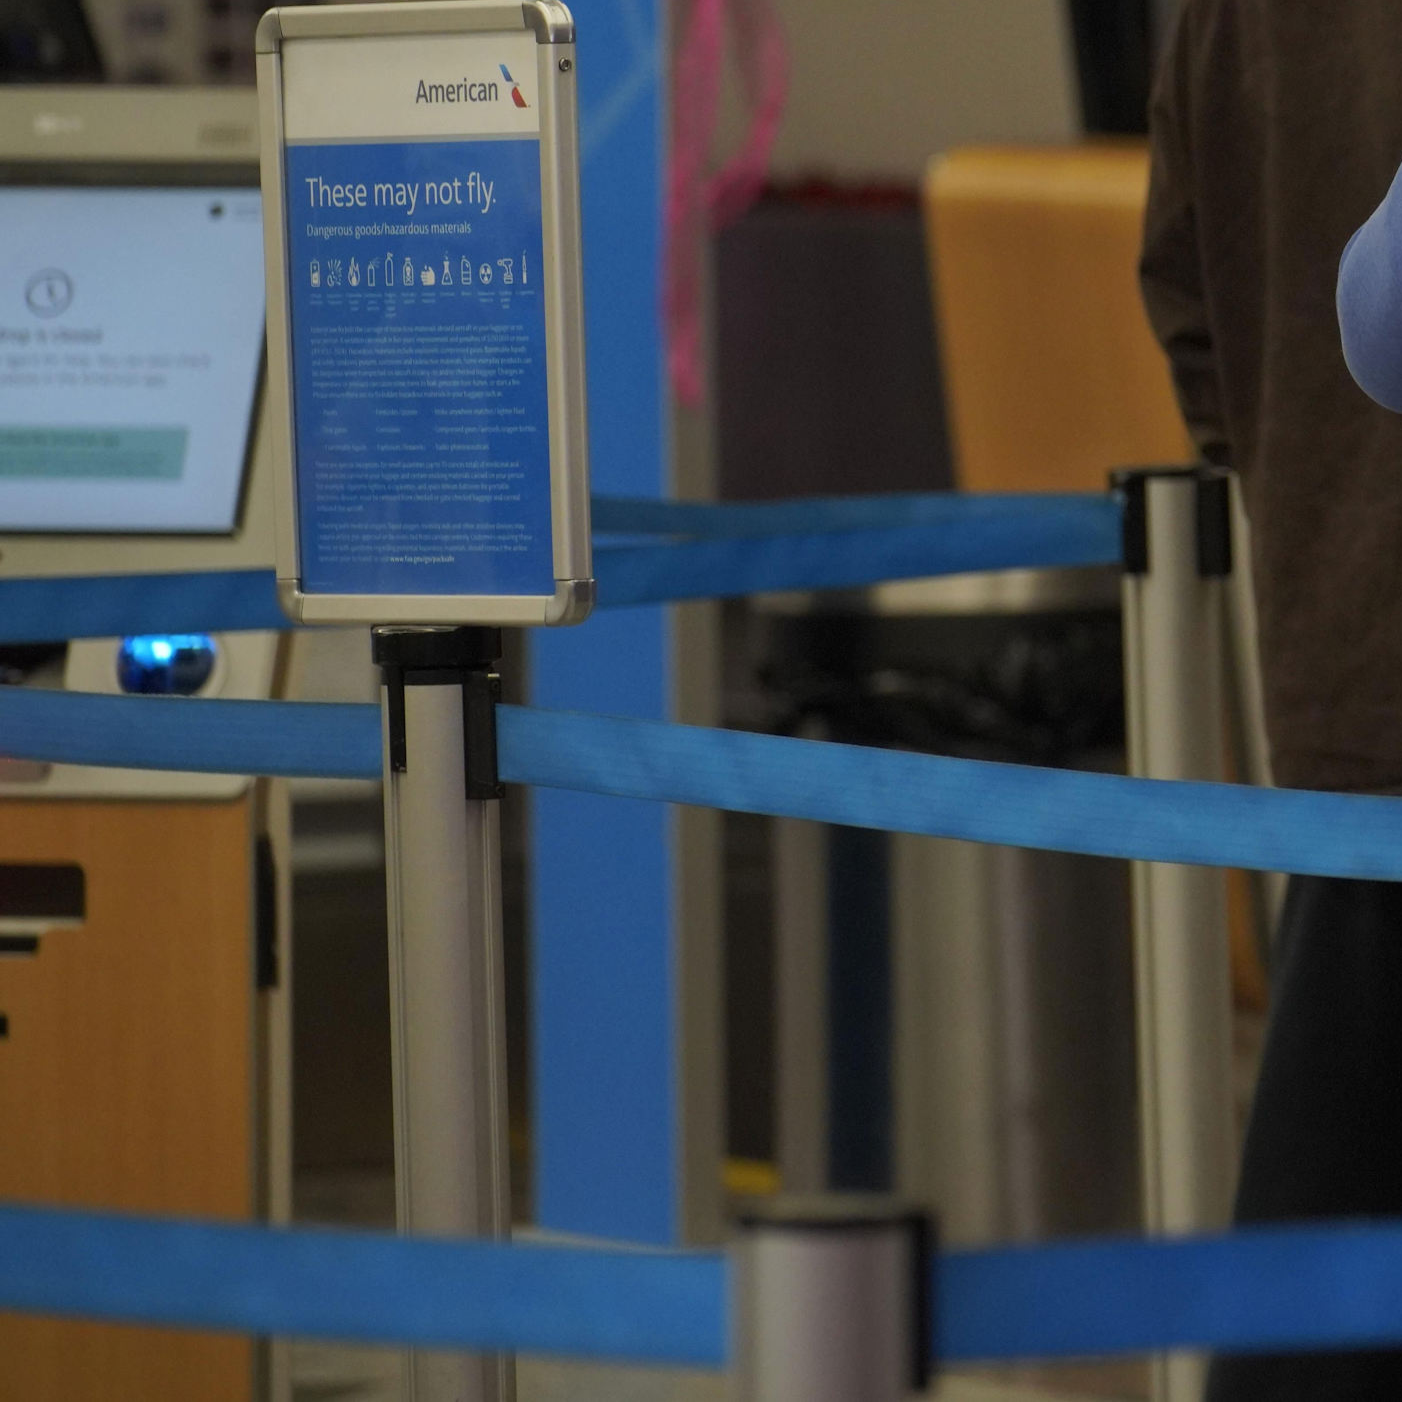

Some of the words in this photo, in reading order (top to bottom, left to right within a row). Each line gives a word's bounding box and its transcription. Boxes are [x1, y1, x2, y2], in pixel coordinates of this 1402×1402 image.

[416, 77, 498, 104] American
[305, 176, 367, 207] These
[374, 182, 419, 215] may
[426, 177, 462, 204] not
[467, 171, 496, 214] fly.
[306, 224, 352, 240] Dangerous
[355, 222, 429, 240] goods/hazardous
[431, 221, 472, 234] materials
